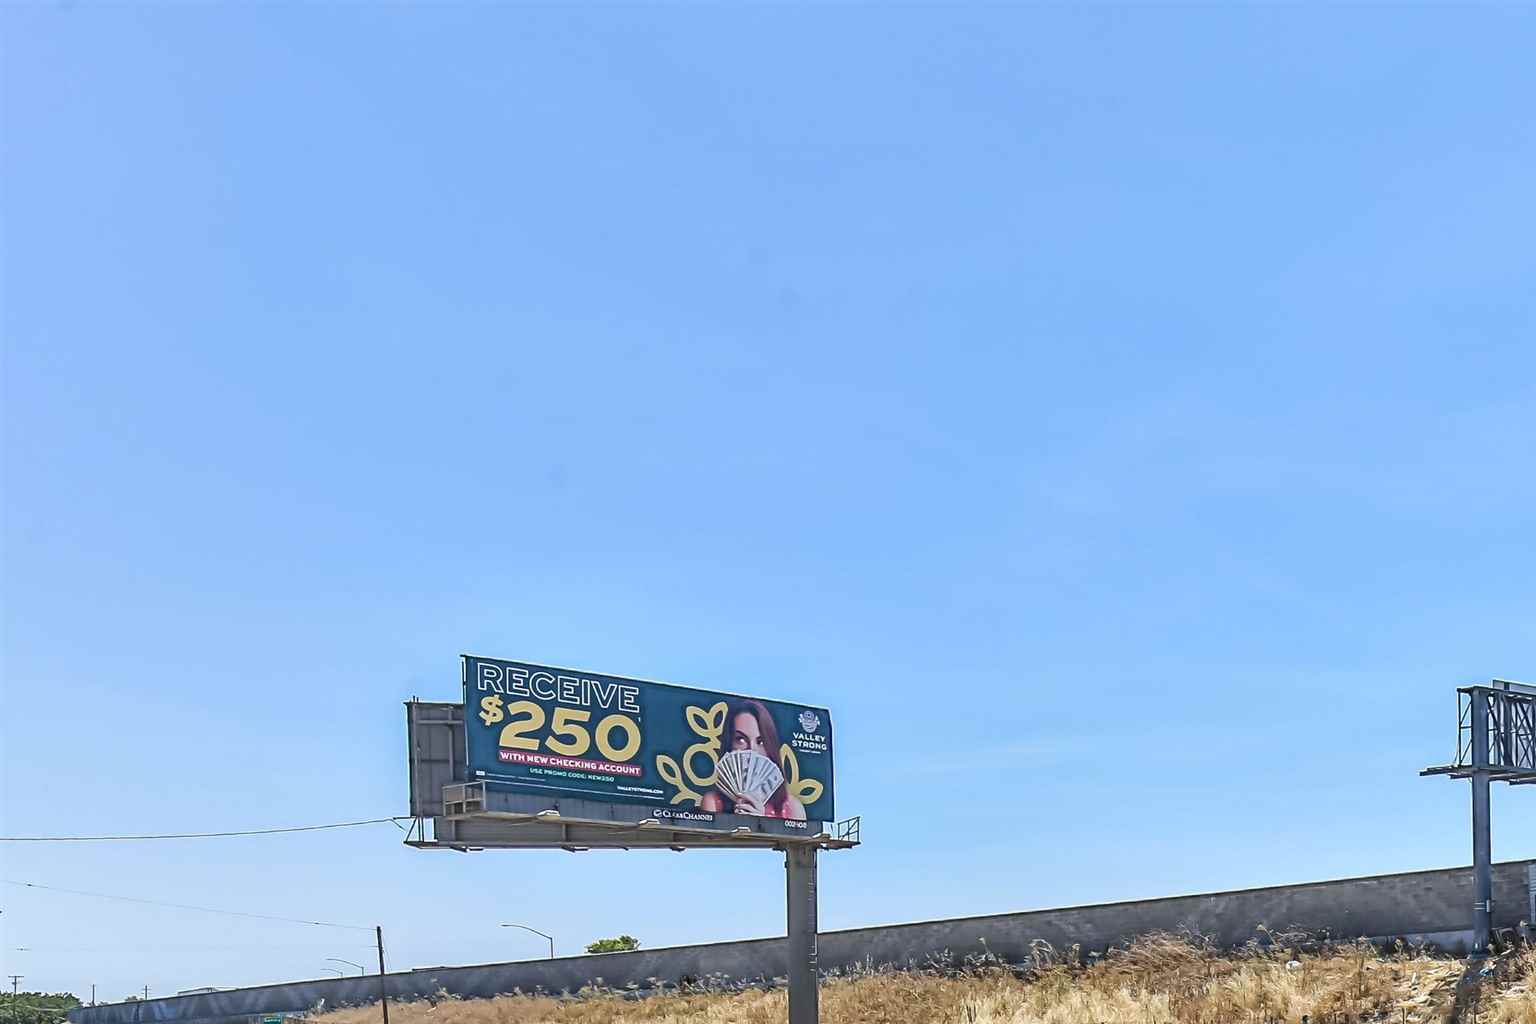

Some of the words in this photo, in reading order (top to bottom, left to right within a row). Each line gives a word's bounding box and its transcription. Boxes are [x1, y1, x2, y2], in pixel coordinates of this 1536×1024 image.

[477, 662, 640, 713] RECEIVE
[793, 732, 826, 742] VALLEY
[792, 740, 827, 751] STRONG
[500, 751, 525, 762] WITH
[526, 755, 548, 765] NEW
[550, 757, 597, 770] CHECKING
[599, 764, 641, 775] ACCOUNT
[529, 767, 543, 775] USE
[544, 769, 567, 777] PROMO
